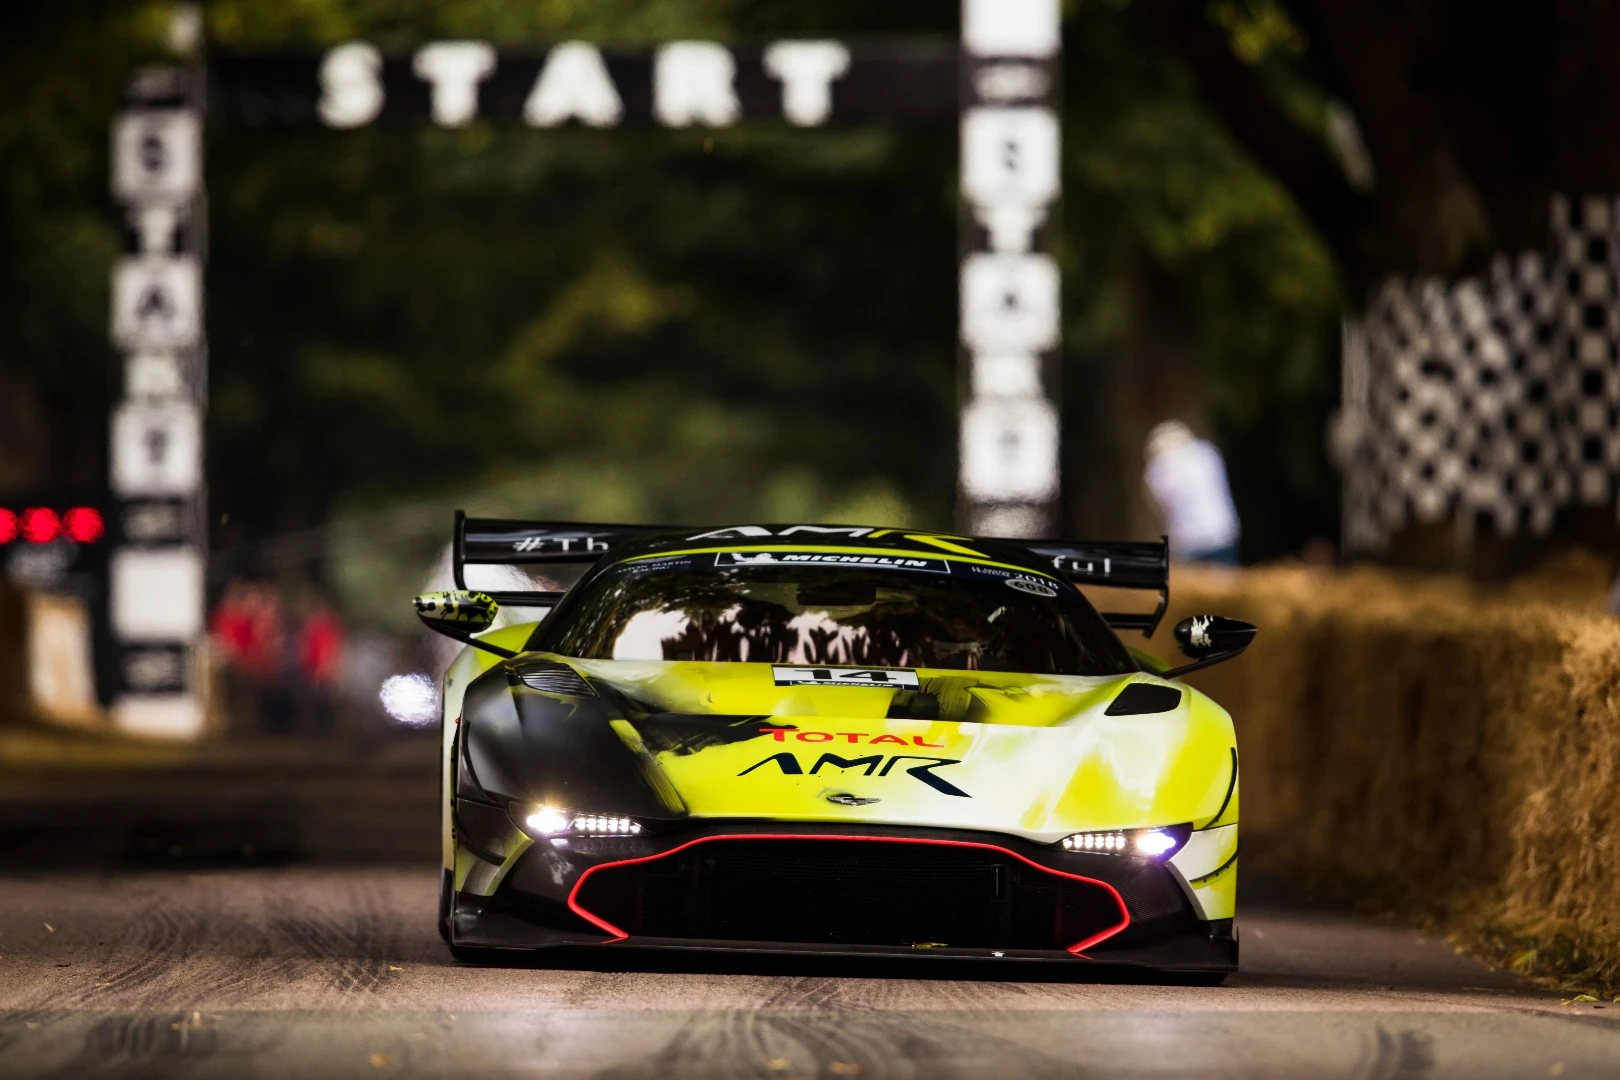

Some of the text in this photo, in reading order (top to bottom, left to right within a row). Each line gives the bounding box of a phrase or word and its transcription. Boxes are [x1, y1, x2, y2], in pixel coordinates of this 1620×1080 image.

[317, 39, 852, 128] START
[685, 525, 992, 559] AMR
[782, 554, 928, 568] MICHELIN
[1051, 555, 1111, 574] ful
[793, 668, 897, 682] 14
[758, 728, 945, 749] TOTAL
[736, 752, 973, 798] AMR
